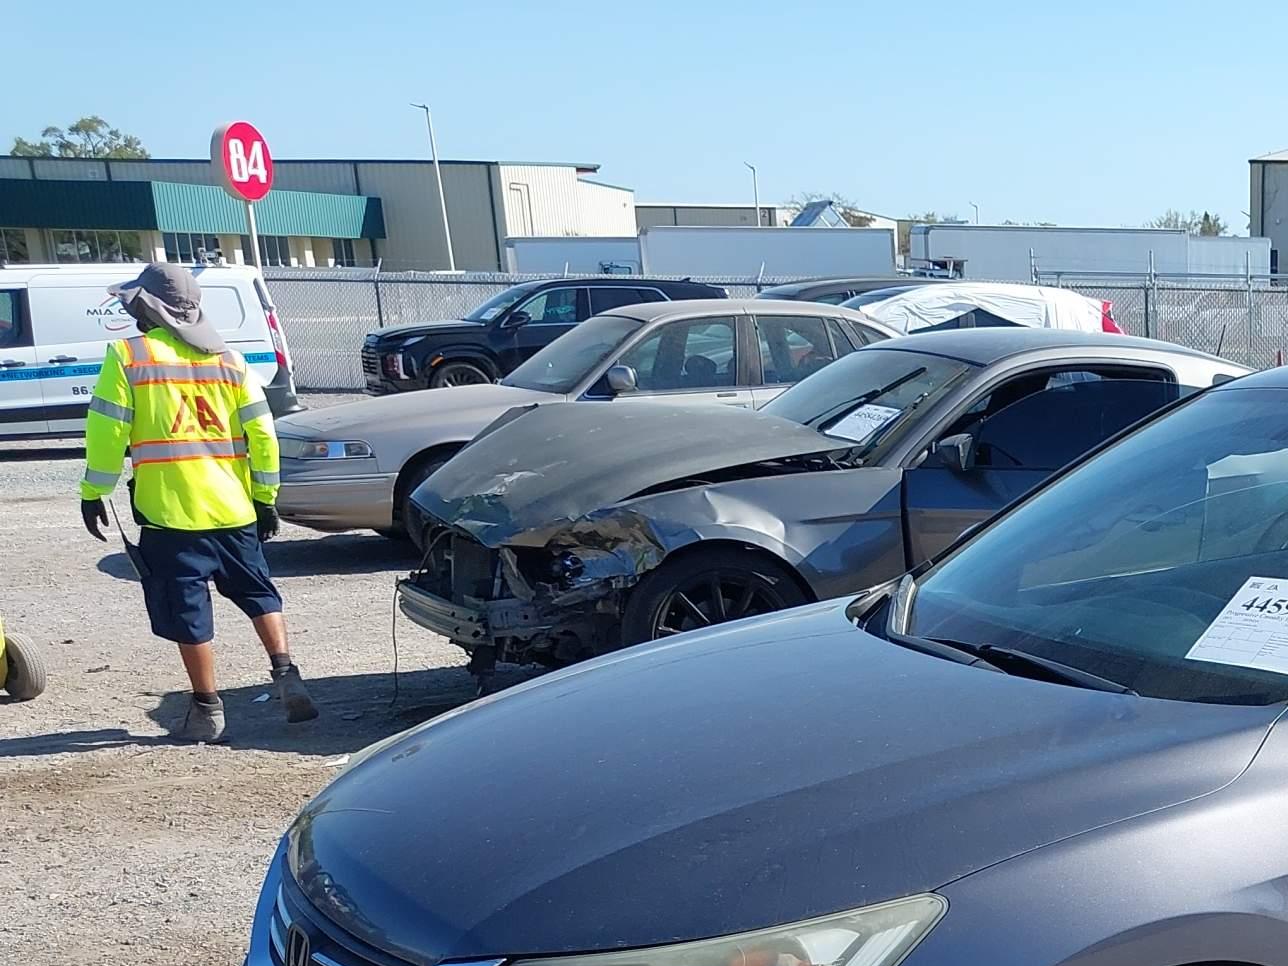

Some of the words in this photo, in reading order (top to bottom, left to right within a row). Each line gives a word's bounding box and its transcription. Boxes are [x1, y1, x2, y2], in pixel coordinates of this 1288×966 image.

[228, 138, 268, 184] 84
[86, 308, 114, 316] MIA
[7, 368, 65, 379] NETWORKING
